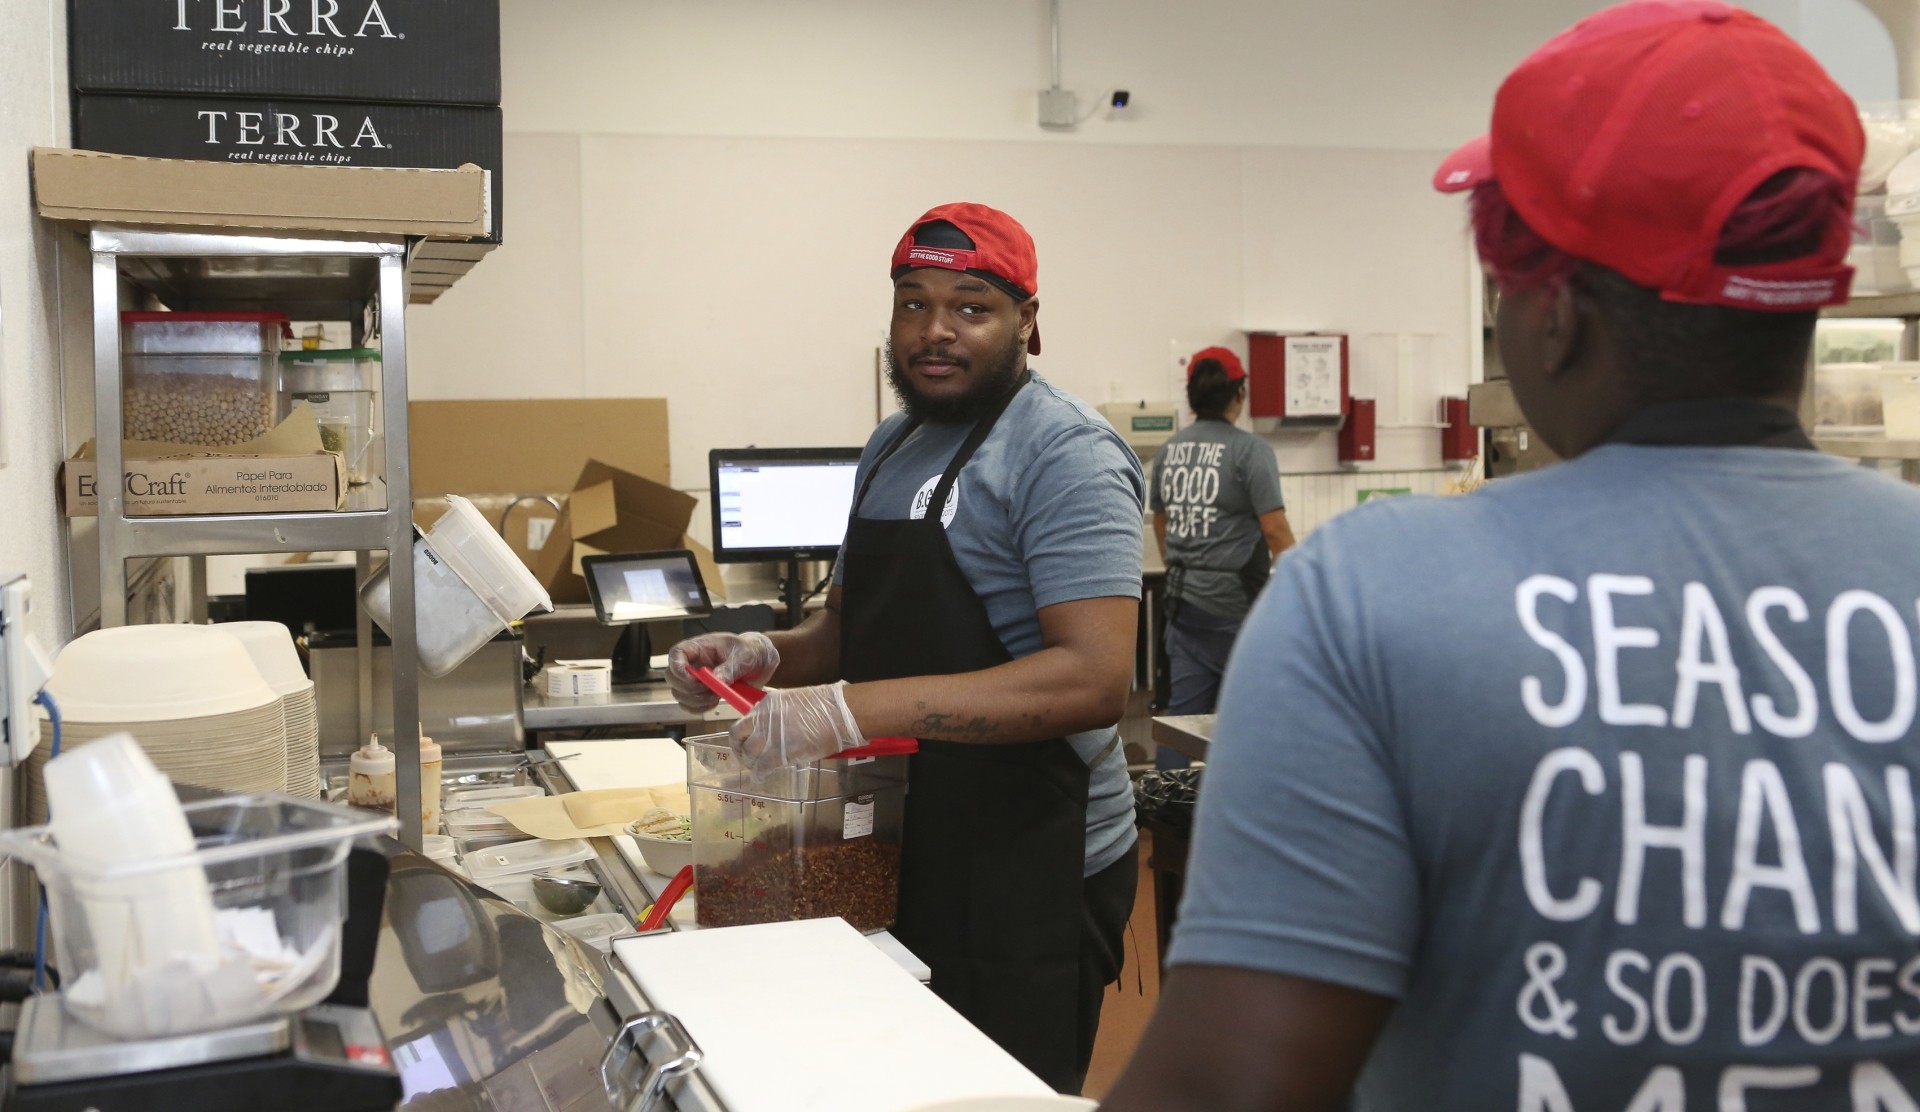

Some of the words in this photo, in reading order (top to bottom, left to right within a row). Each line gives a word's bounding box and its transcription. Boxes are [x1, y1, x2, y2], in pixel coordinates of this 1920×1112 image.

[172, 0, 397, 38] TERRA
[201, 40, 233, 51] real
[239, 41, 310, 55] vegetable
[316, 43, 355, 58] chips
[198, 110, 386, 149] TERRA
[228, 151, 254, 160] real
[258, 151, 316, 163] vegetable
[320, 152, 352, 164] chips
[1164, 441, 1196, 467] JUST
[1198, 442, 1226, 468] THE
[205, 483, 257, 494] Alimentos
[259, 482, 328, 493] Interdoblado
[236, 471, 267, 482] Papel
[269, 470, 293, 480] Para
[1161, 465, 1220, 505] GOOD
[1166, 504, 1218, 539] TUFF
[1515, 572, 1920, 744] SEASO
[1518, 747, 1920, 935] CHAN
[1602, 949, 1708, 1046] SO
